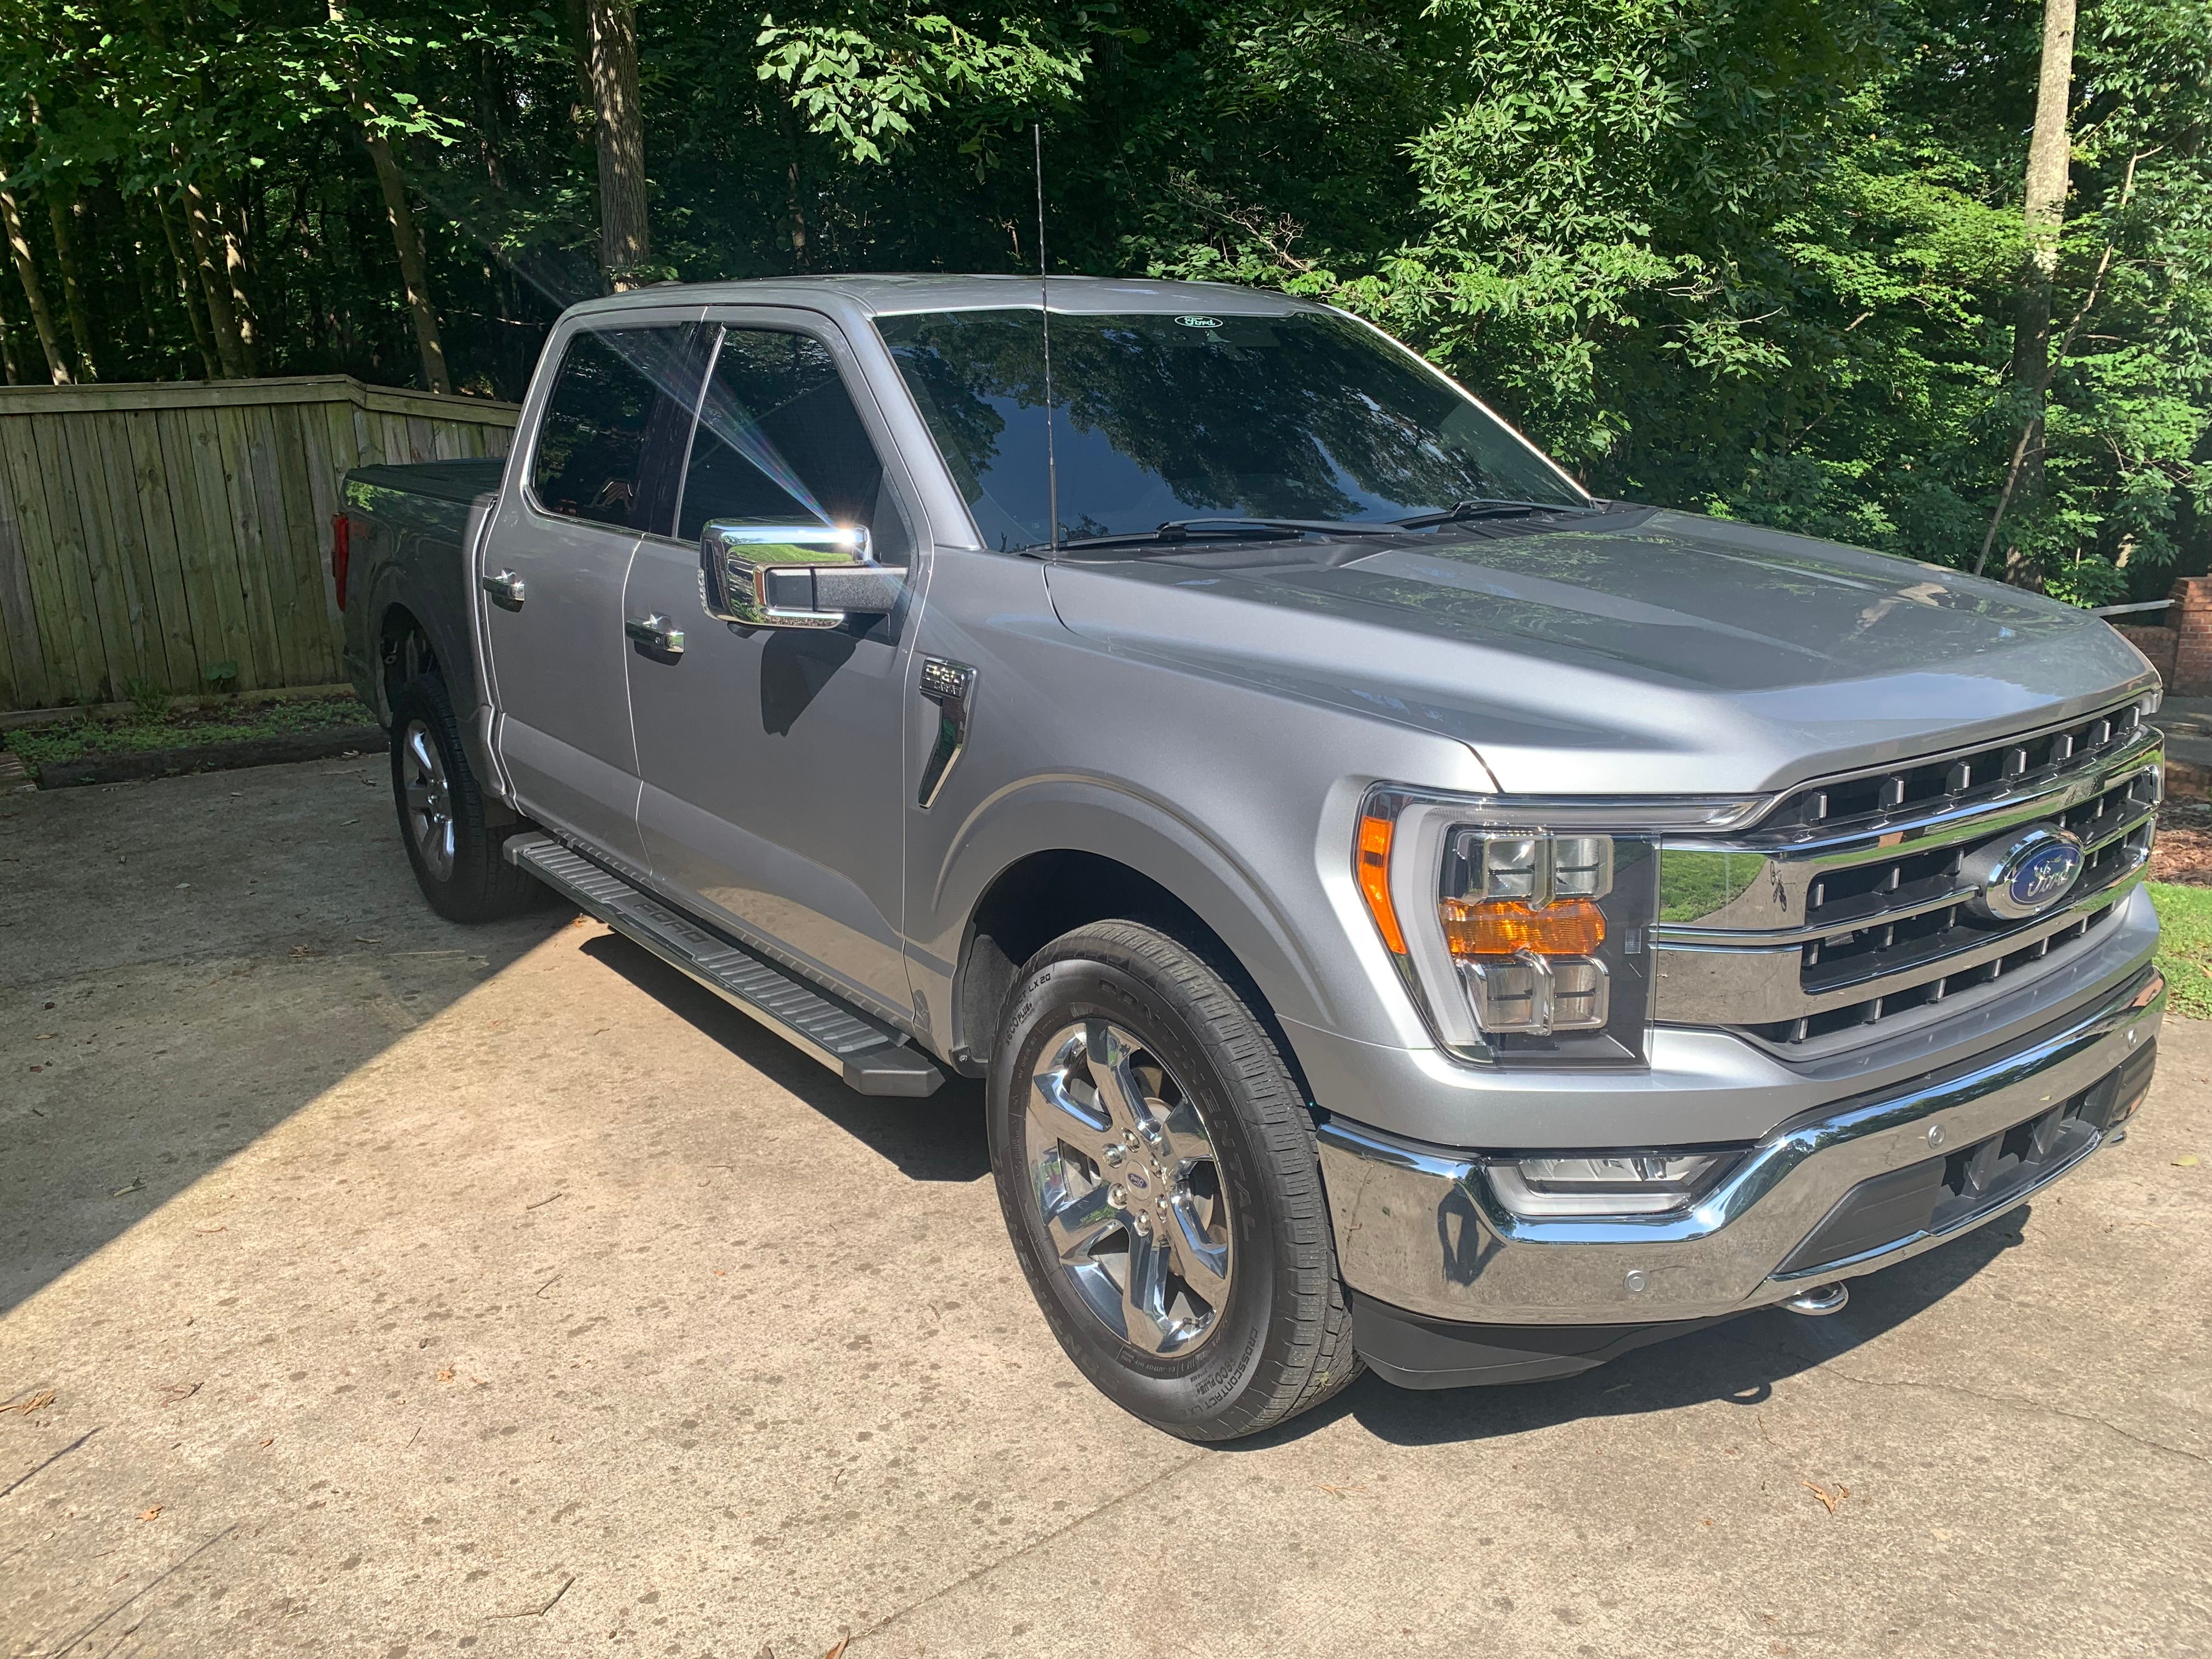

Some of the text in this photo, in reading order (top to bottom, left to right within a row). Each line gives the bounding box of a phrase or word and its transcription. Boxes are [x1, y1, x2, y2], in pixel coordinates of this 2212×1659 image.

[1184, 317, 1216, 325] Ford
[2027, 854, 2072, 897] Ford
[634, 903, 710, 944] FORD
[1028, 973, 1051, 992] LX 20
[1097, 977, 1256, 1242] CONTINENTAL
[1130, 1174, 1144, 1188] Ford
[1205, 1326, 1260, 1410] CROSSCONTACT
